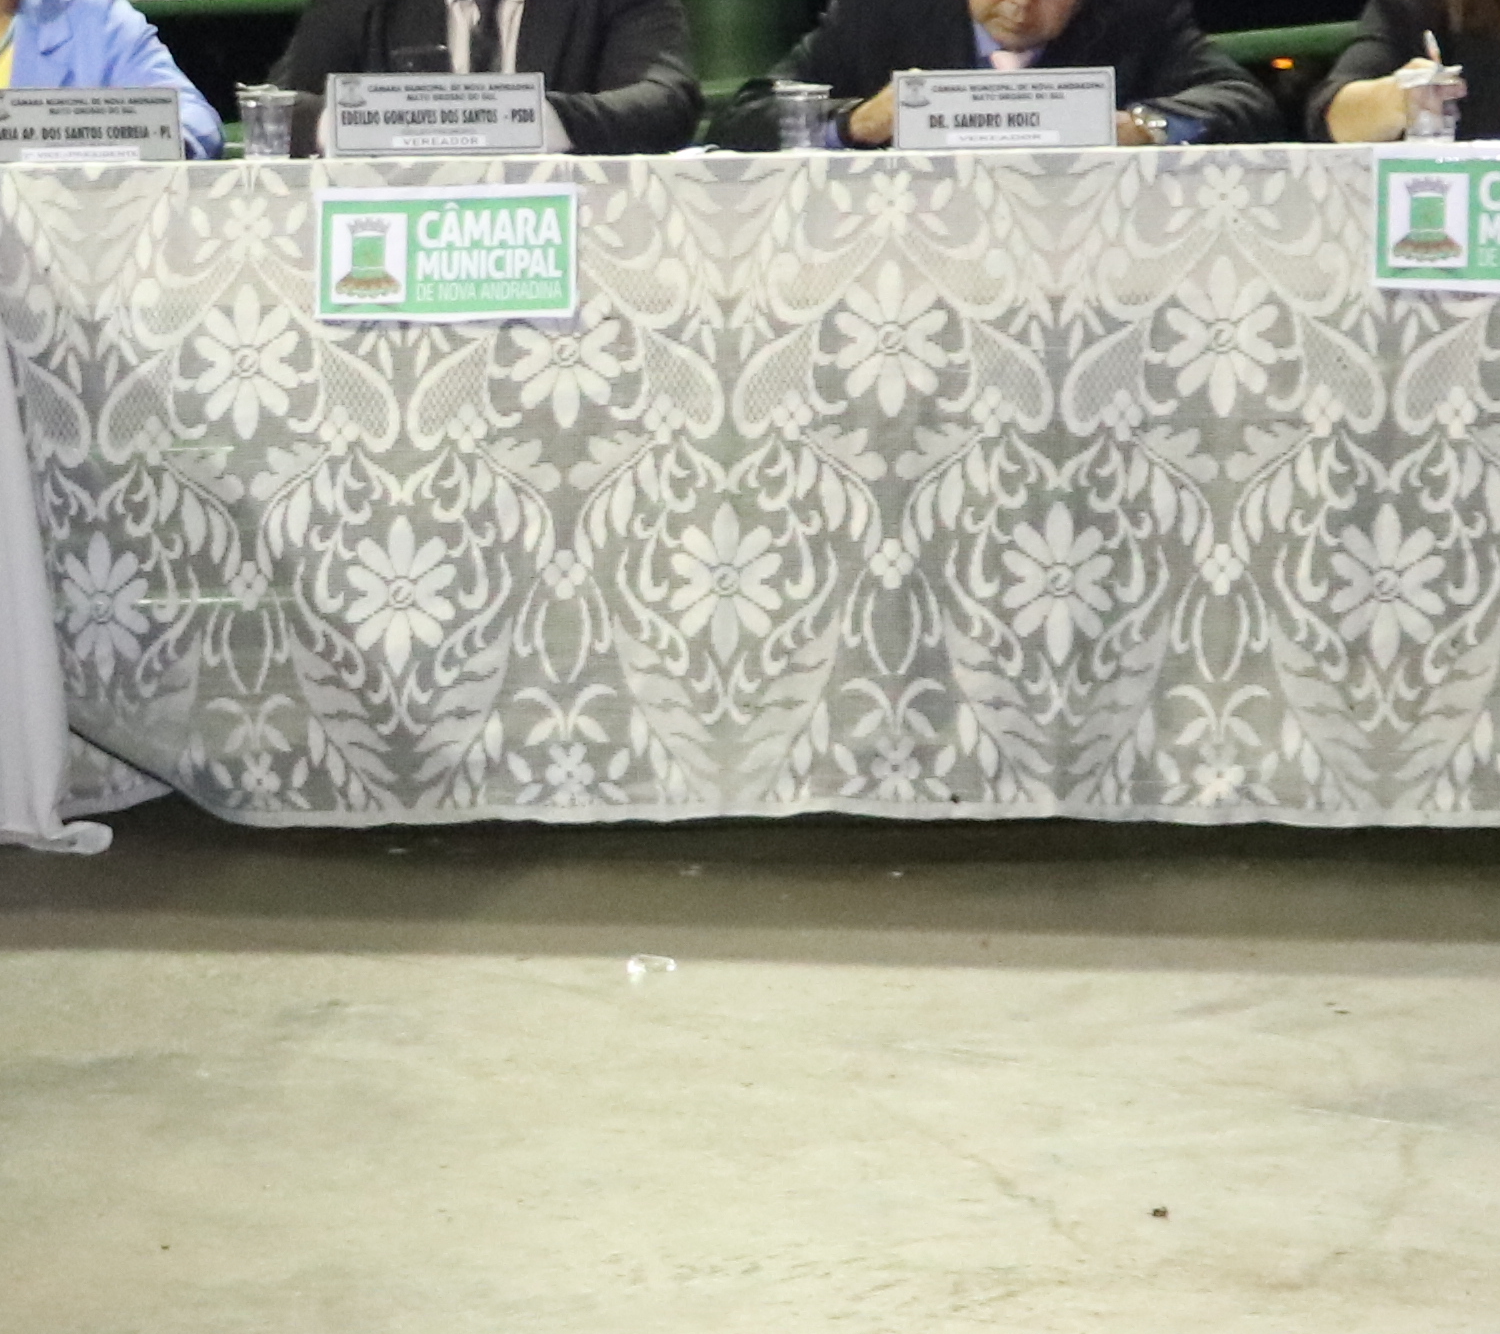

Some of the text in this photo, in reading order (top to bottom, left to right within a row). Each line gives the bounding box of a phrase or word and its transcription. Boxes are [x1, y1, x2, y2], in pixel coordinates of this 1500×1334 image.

[441, 110, 459, 124] DOS
[462, 109, 498, 124] SANTOS
[954, 113, 1002, 128] SANDRO
[42, 127, 61, 140] DOS
[65, 126, 102, 139] SANTOS
[402, 136, 480, 146] VEREADOR
[416, 202, 562, 248] CÂMARA
[416, 248, 563, 281] MUNICIPAL
[1478, 249, 1498, 266] DE
[416, 281, 562, 302] DE NOVA ANDRADINA
